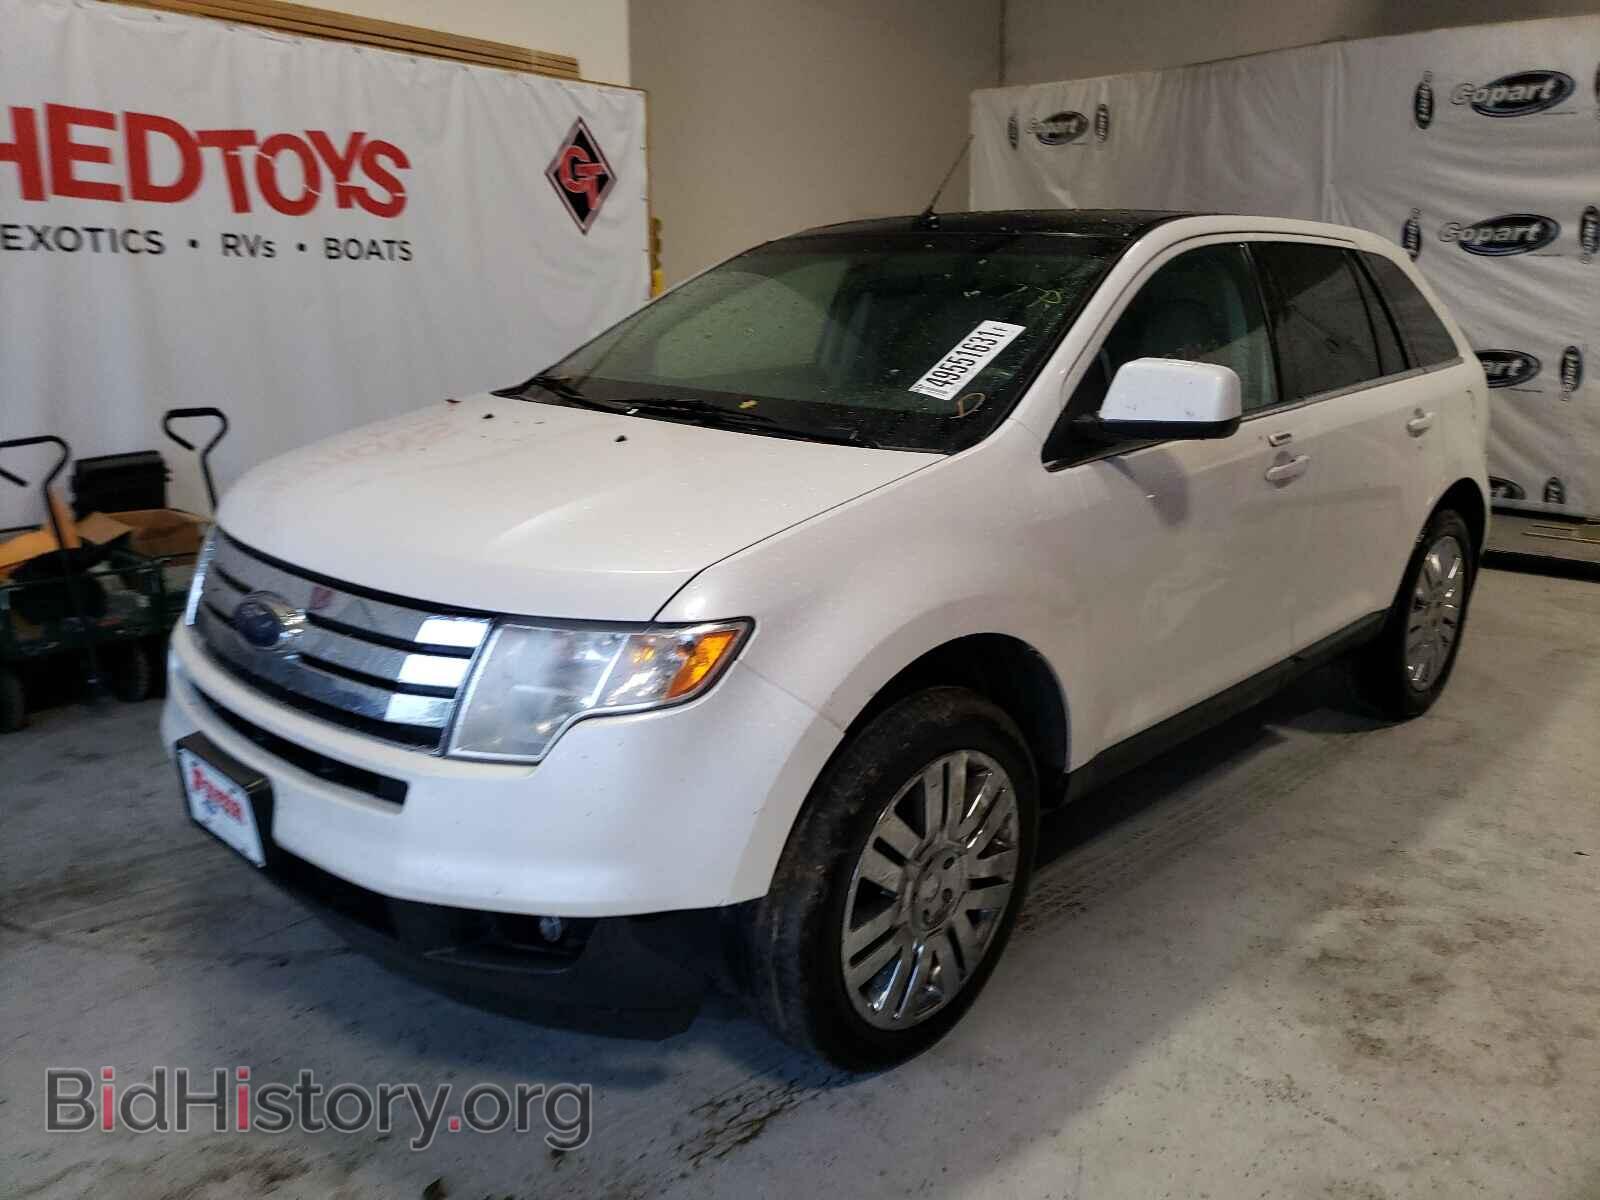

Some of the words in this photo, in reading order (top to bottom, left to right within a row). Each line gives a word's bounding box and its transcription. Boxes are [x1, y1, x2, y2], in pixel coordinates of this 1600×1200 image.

[0, 223, 166, 255] EXOTICS
[221, 232, 277, 258] RVs
[324, 237, 413, 262] BOATS
